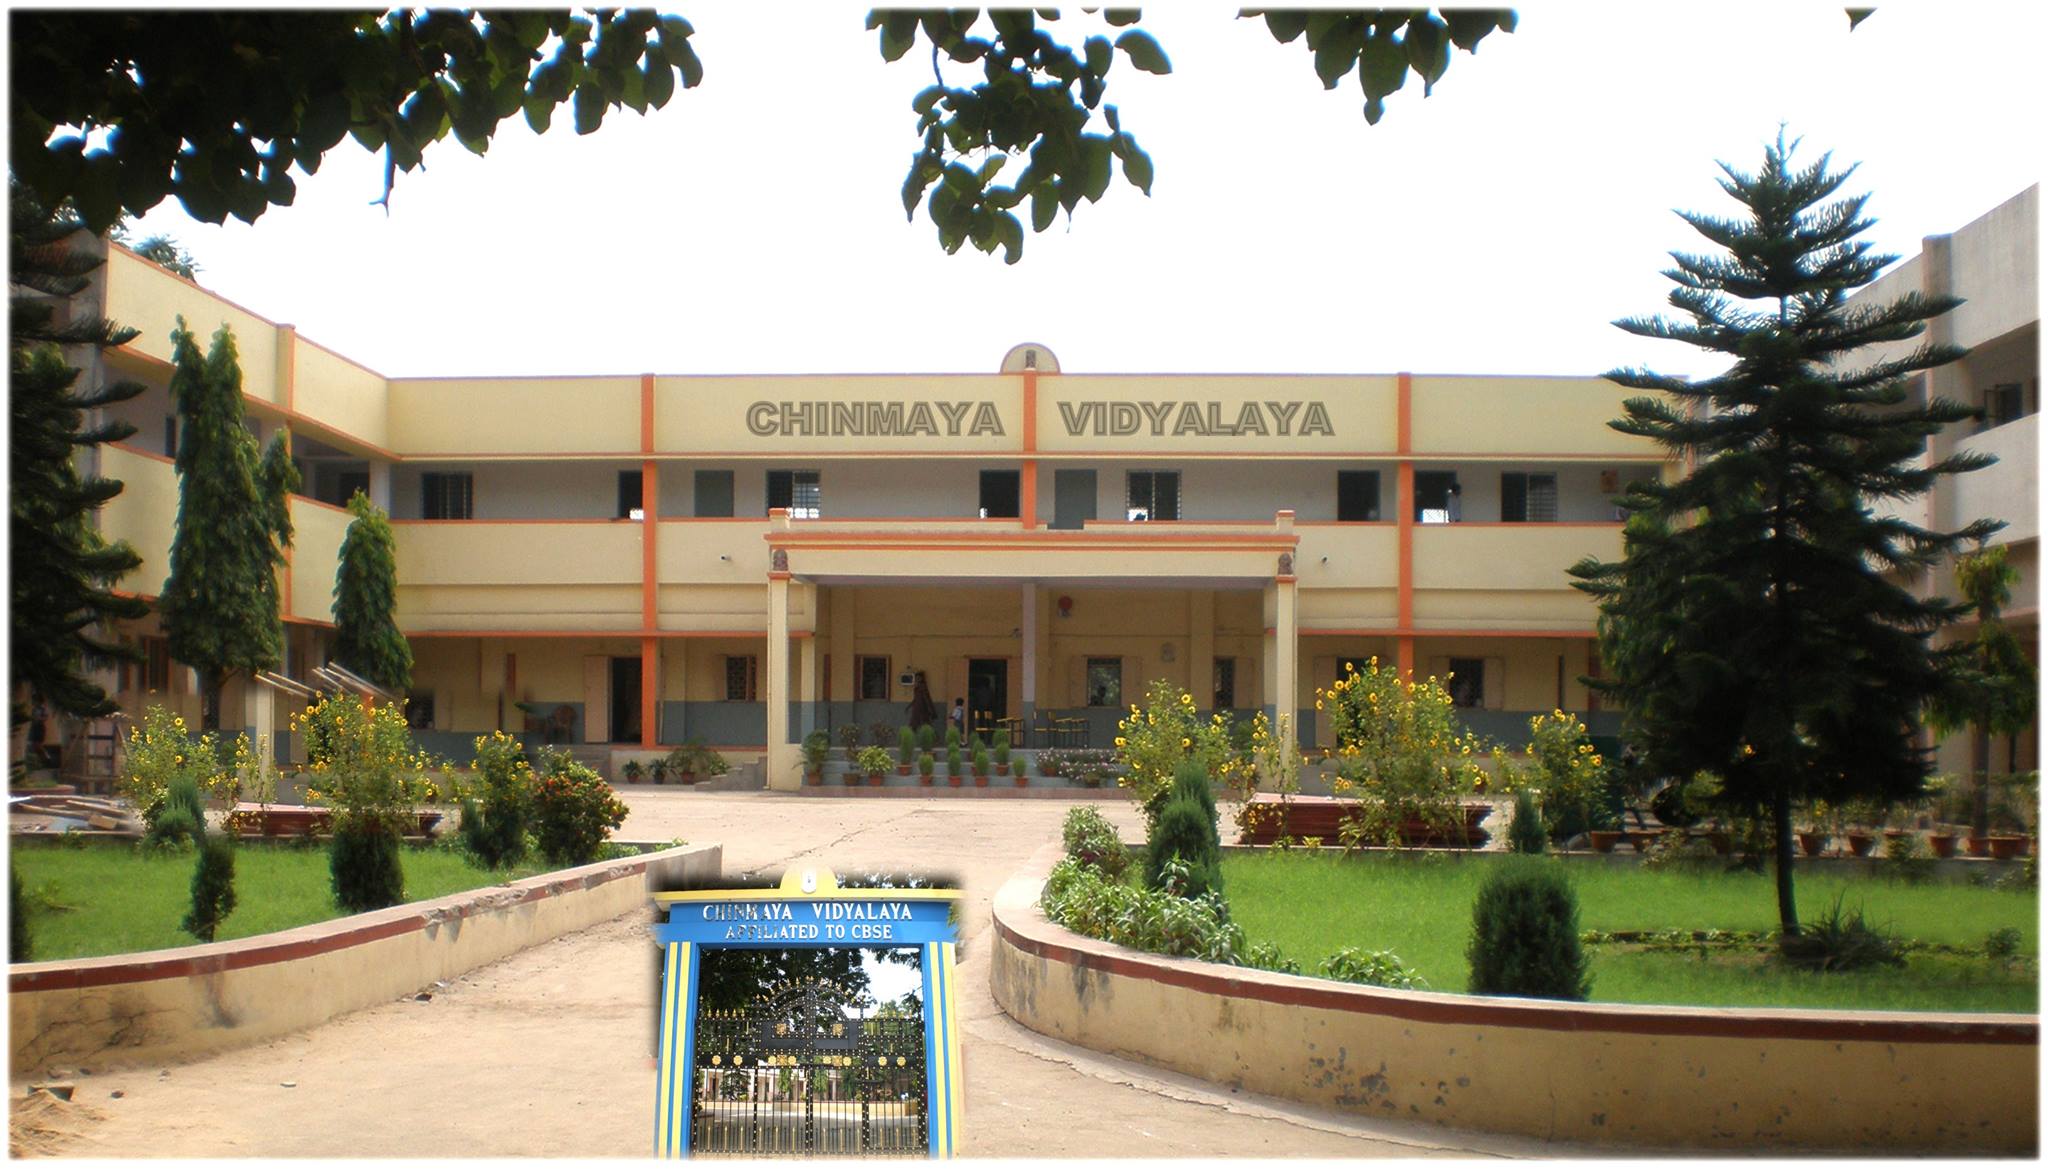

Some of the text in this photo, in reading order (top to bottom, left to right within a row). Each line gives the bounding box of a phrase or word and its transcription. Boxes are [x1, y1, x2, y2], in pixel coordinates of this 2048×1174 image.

[746, 401, 1336, 437] CHINMAYA VIDYALAYA
[702, 902, 913, 921] CHINMAYA VIDYALAYA
[725, 924, 893, 940] AFFILIATED TO CBSE
